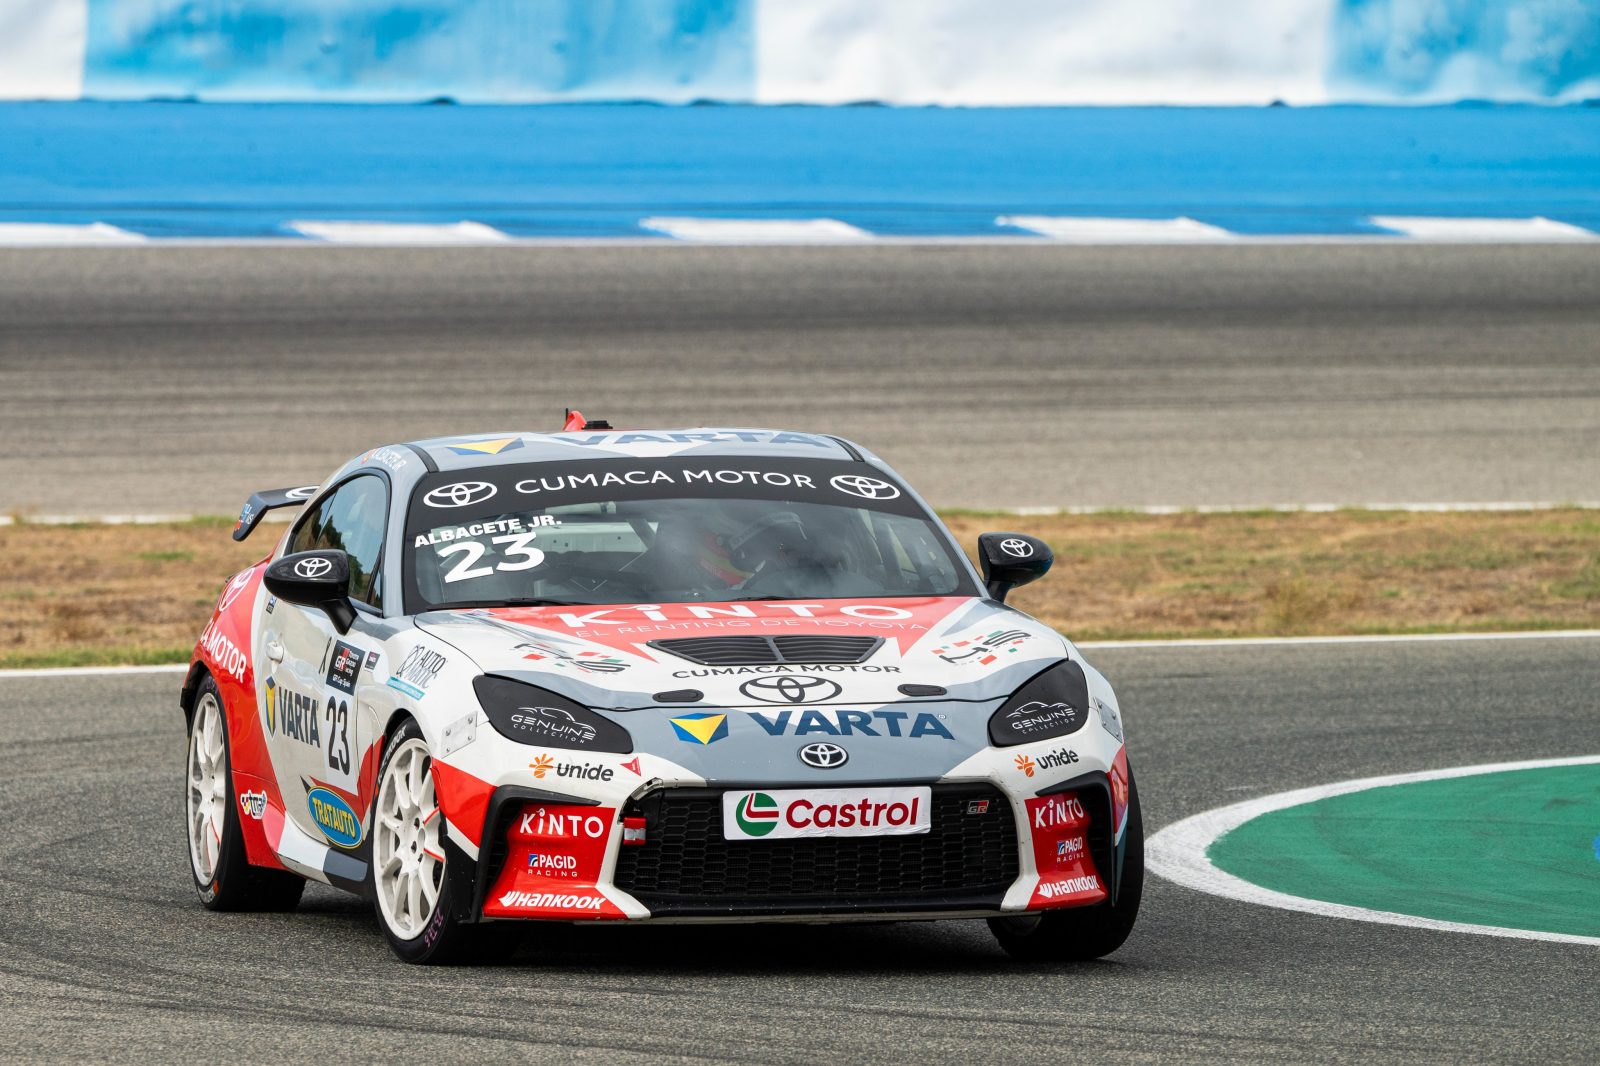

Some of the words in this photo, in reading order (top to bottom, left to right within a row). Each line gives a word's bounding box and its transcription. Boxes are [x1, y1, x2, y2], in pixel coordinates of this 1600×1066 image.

[552, 432, 831, 449] VARTA
[515, 470, 675, 494] CUMACA
[682, 469, 817, 489] MOTOR
[415, 518, 522, 548] ALBACETE
[528, 514, 562, 528] JR.
[437, 531, 545, 583] 23
[575, 630, 608, 638] EL
[617, 620, 752, 634] RENTING
[805, 619, 928, 630] TOYOTA
[207, 626, 247, 684] MOTOR
[417, 650, 447, 674] AUTO
[672, 665, 794, 679] CUMACA
[800, 664, 902, 674] MOTOR
[279, 686, 321, 748] VARTA
[511, 714, 596, 741] GENUINE
[750, 710, 955, 740] VARTA
[1012, 707, 1076, 730] GENUINE
[1022, 717, 1075, 735] COLLECTION
[325, 695, 350, 776] 23
[513, 723, 584, 744] COLLECTION
[1036, 748, 1079, 770] unide
[556, 762, 614, 782] unide
[312, 796, 356, 839] TRATAUTO
[785, 797, 920, 829] Castrol
[1065, 836, 1083, 853] PAGID
[527, 869, 578, 877] RACING
[539, 854, 577, 869] PAGID
